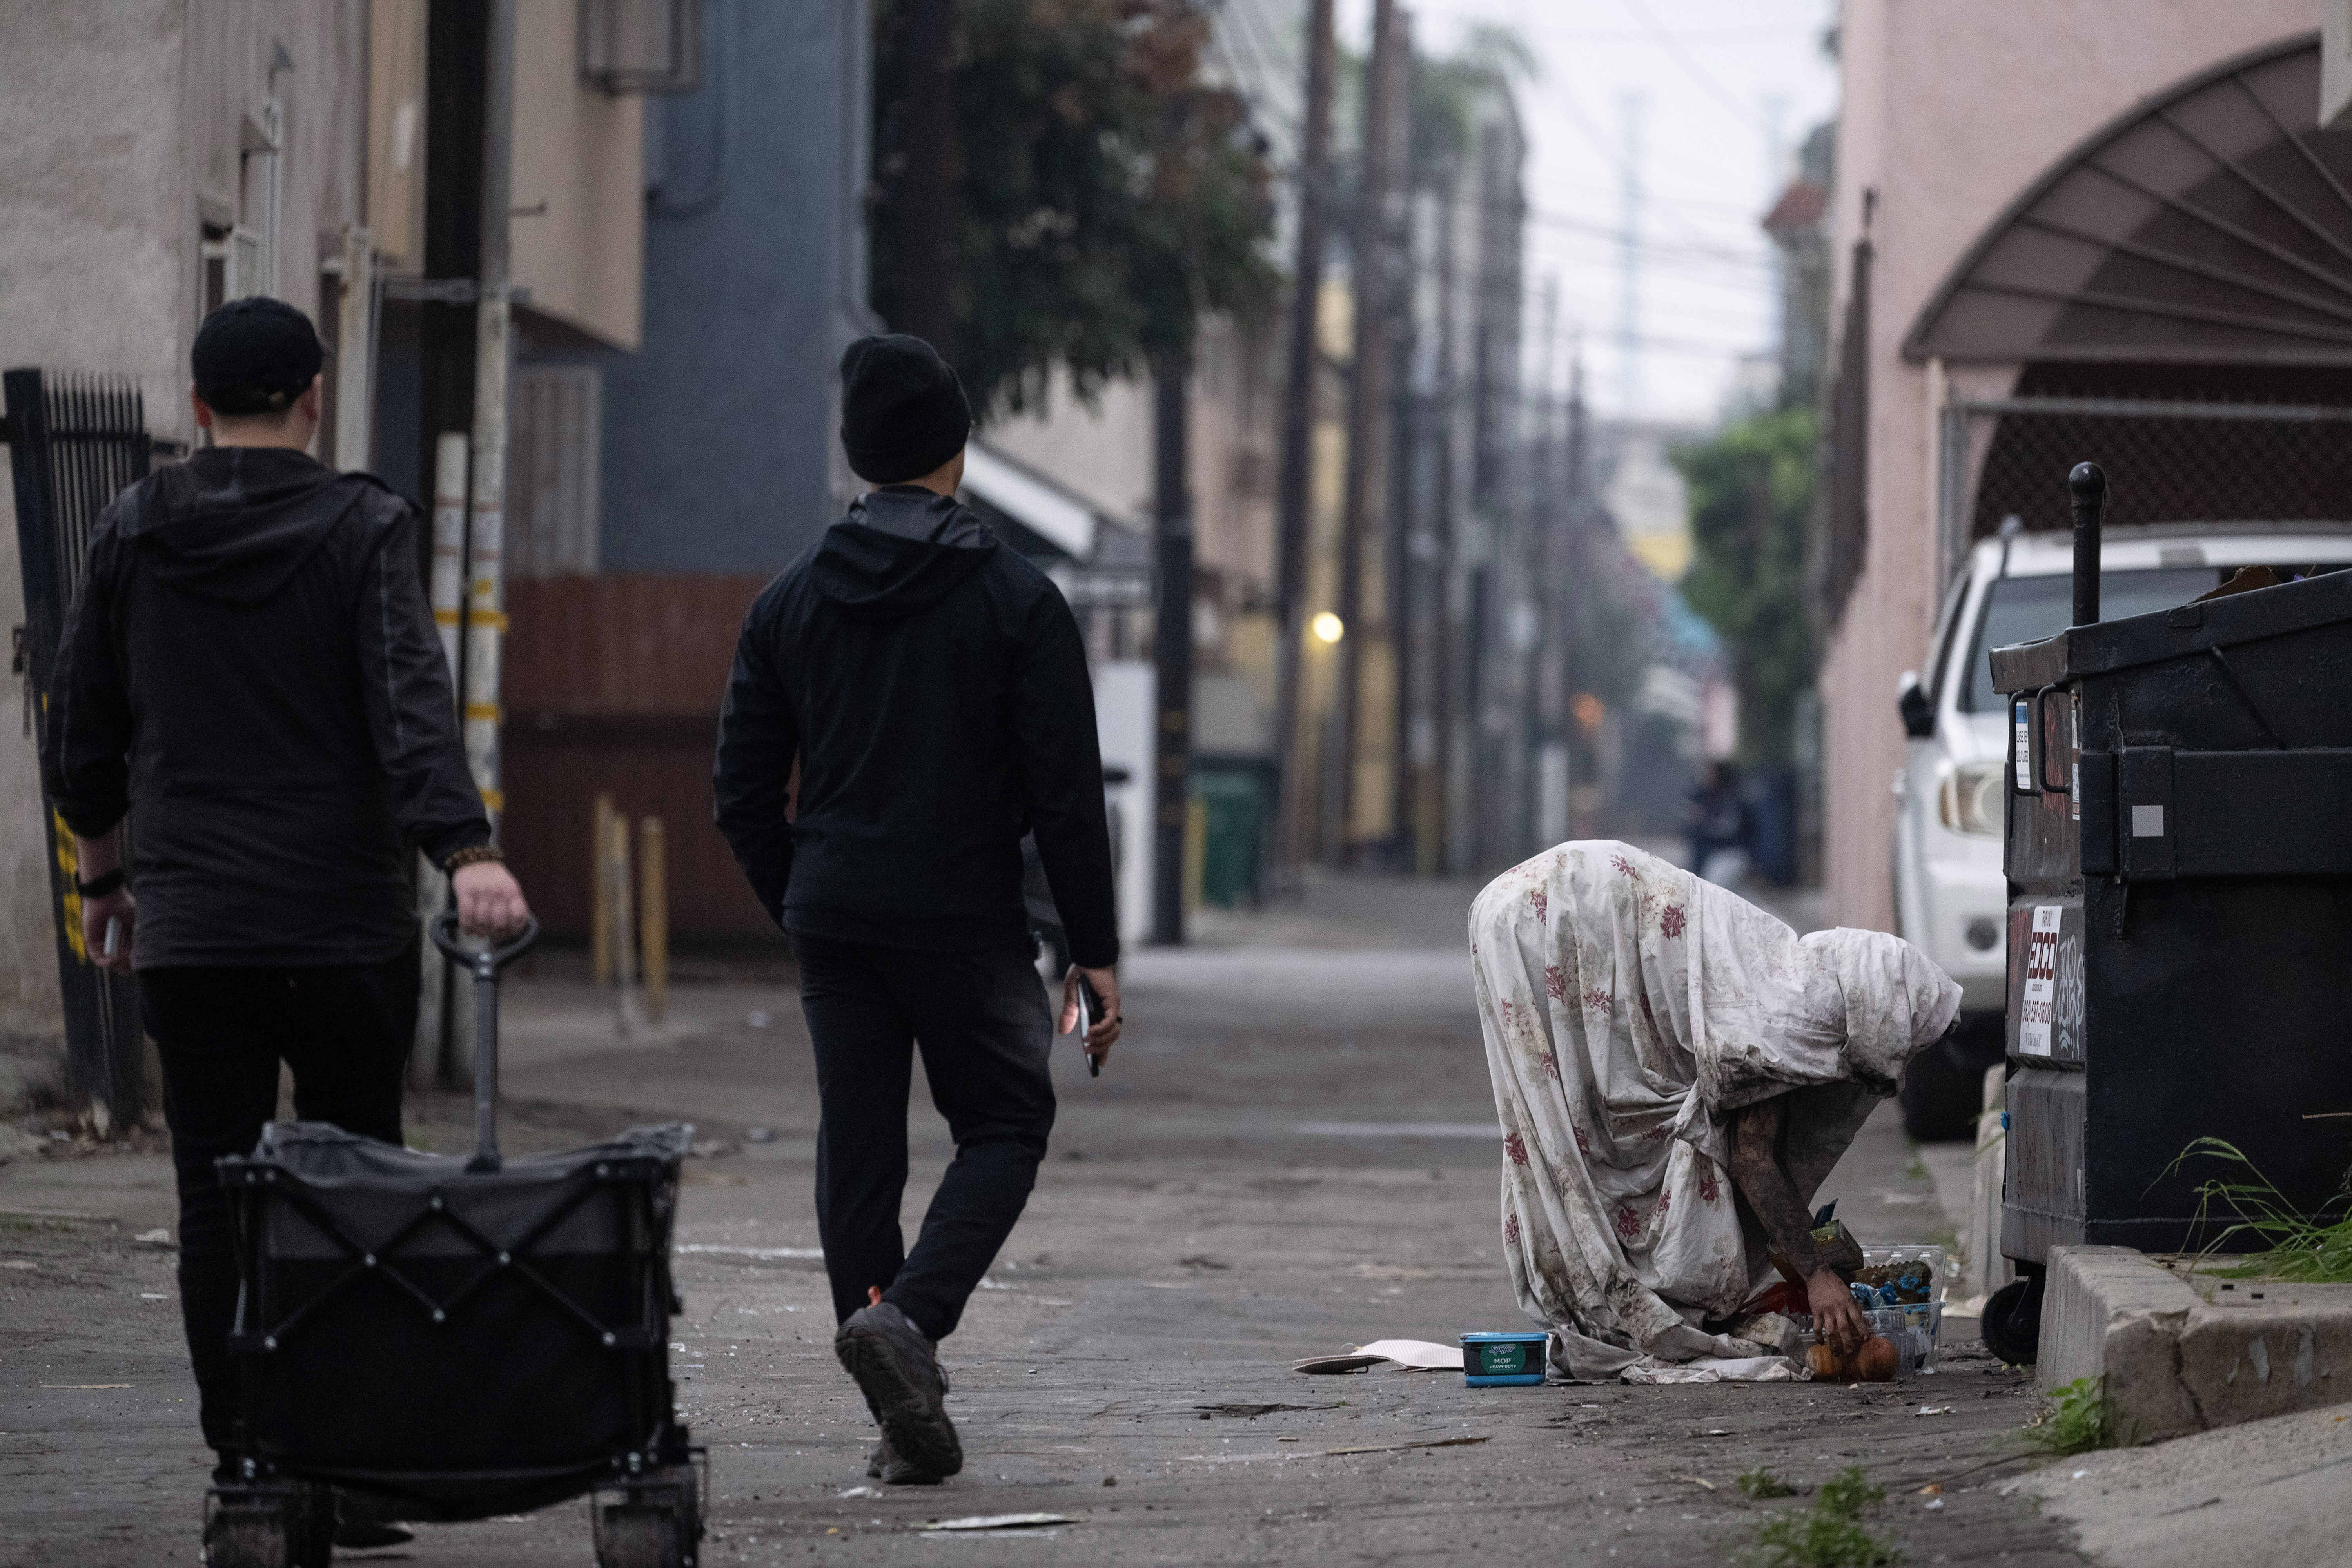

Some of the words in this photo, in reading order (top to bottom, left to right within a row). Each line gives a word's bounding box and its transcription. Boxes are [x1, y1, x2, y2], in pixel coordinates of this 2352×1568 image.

[2028, 932, 2057, 980] EDCO
[2030, 1000, 2051, 1024] 597-0608
[1489, 1345, 1515, 1354] Swiffer
